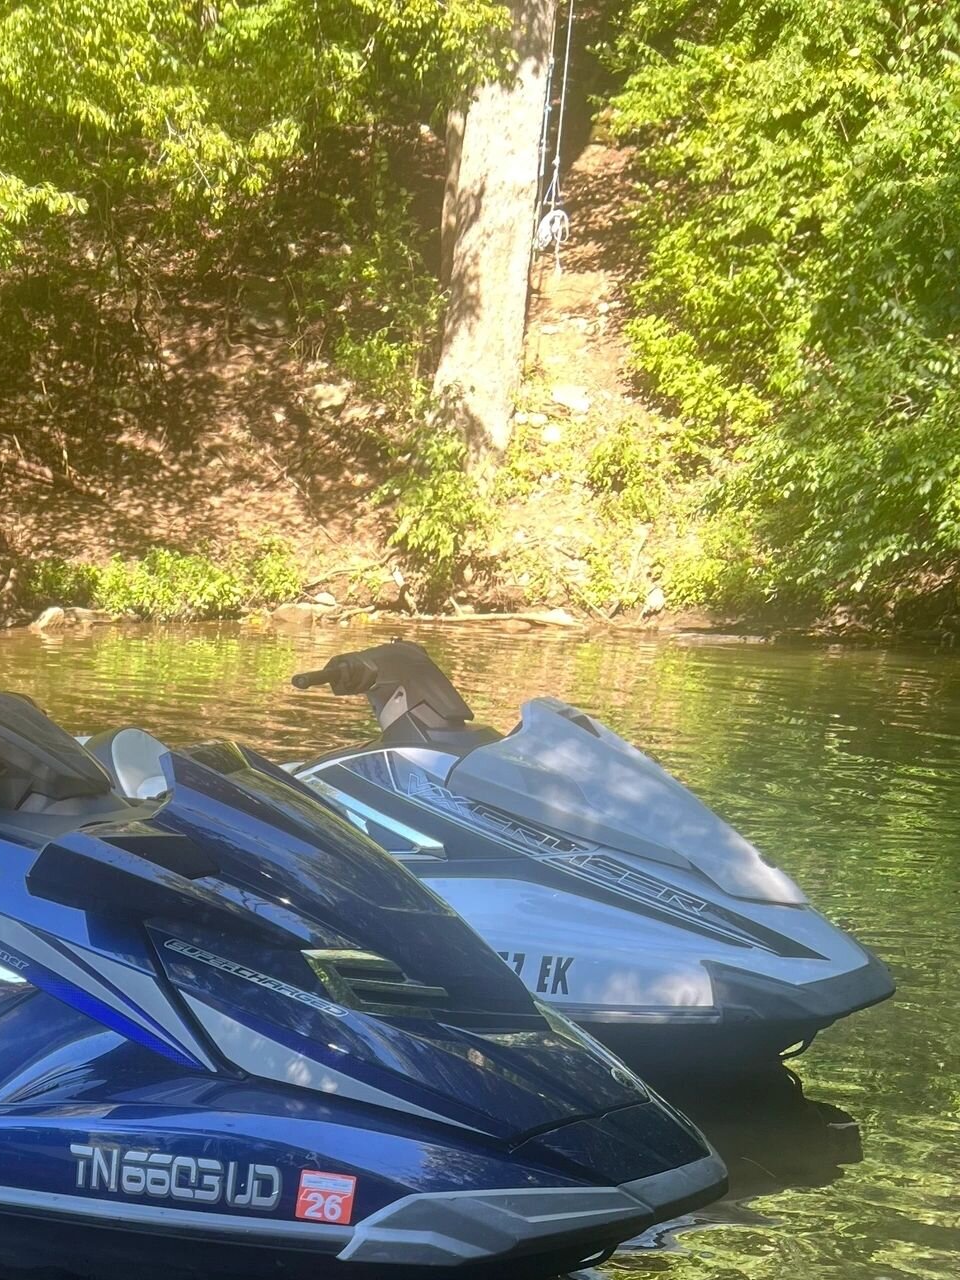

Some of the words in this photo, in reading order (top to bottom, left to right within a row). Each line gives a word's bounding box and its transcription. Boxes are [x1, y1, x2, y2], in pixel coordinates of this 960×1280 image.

[471, 805, 707, 915] CRUISER
[168, 939, 347, 1017] SUPERCHARGED
[536, 955, 575, 995] EK
[304, 1192, 342, 1221] 26
